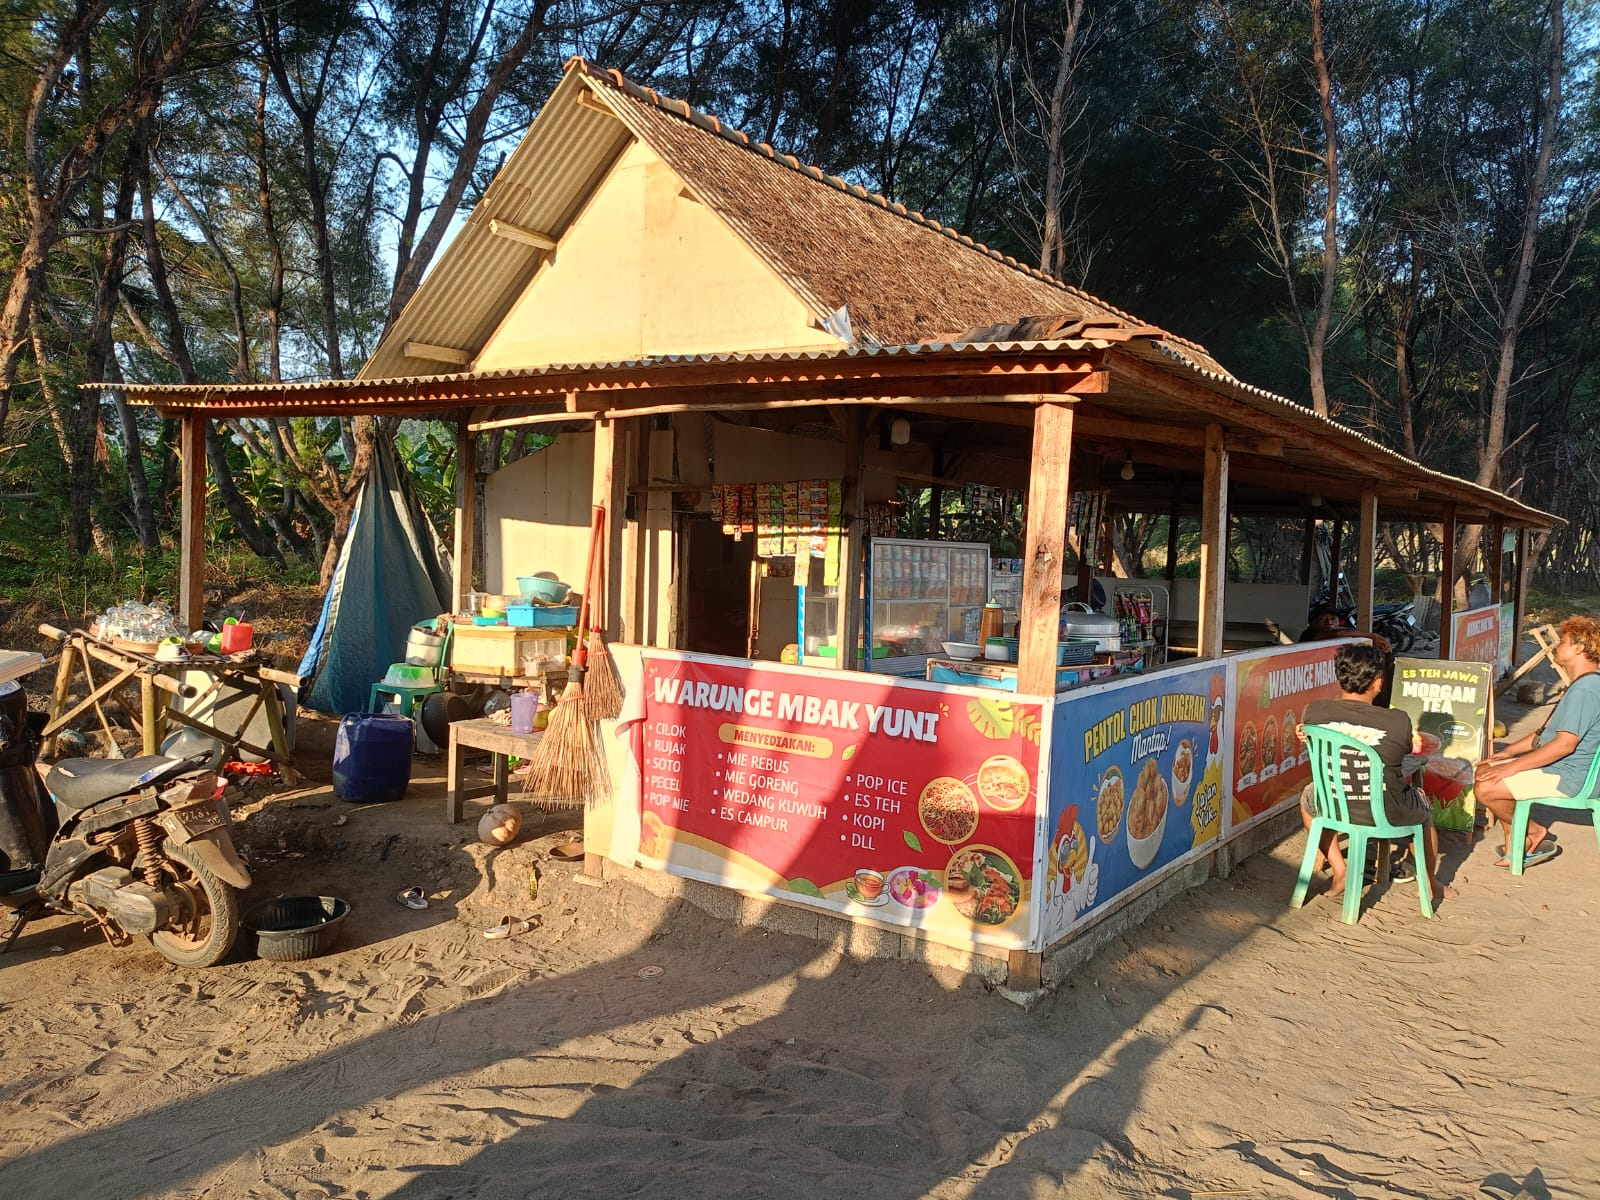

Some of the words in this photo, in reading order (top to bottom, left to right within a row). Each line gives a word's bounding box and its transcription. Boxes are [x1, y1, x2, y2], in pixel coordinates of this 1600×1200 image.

[1269, 664, 1314, 699] WARUNGE
[1402, 669, 1417, 679] ES
[1419, 668, 1441, 678] TEH
[1443, 670, 1480, 684] JAWA
[1402, 681, 1477, 703] MORGAN
[654, 677, 775, 718] WARUNGE
[777, 692, 861, 731] MBAK
[864, 703, 940, 743] YUNI
[1421, 697, 1454, 715] TEA
[656, 723, 687, 738] CILOK
[1084, 708, 1126, 764] PENTOL
[1129, 696, 1158, 736] CILOK
[1160, 693, 1206, 724] ANUGERAH
[654, 739, 687, 756] RUJAK
[734, 729, 815, 753] MENYEDIAKAN:
[1130, 725, 1172, 767] Mantap!
[652, 757, 681, 773] SOTO
[727, 752, 748, 767] MIE
[751, 755, 789, 774] REBUS
[651, 775, 681, 792] PECEL
[724, 769, 746, 785] MIE
[749, 773, 799, 798] GORENG
[856, 774, 884, 790] POP
[887, 779, 908, 795] ICE
[649, 792, 671, 807] POP
[723, 788, 775, 813] WEDANG
[778, 798, 827, 820] KUWUH
[855, 793, 871, 808] ES
[874, 796, 901, 814] TEH
[720, 807, 735, 821] ES
[737, 810, 789, 832] CAMPUR
[853, 813, 885, 831] KOPI
[851, 833, 876, 850] DLL
